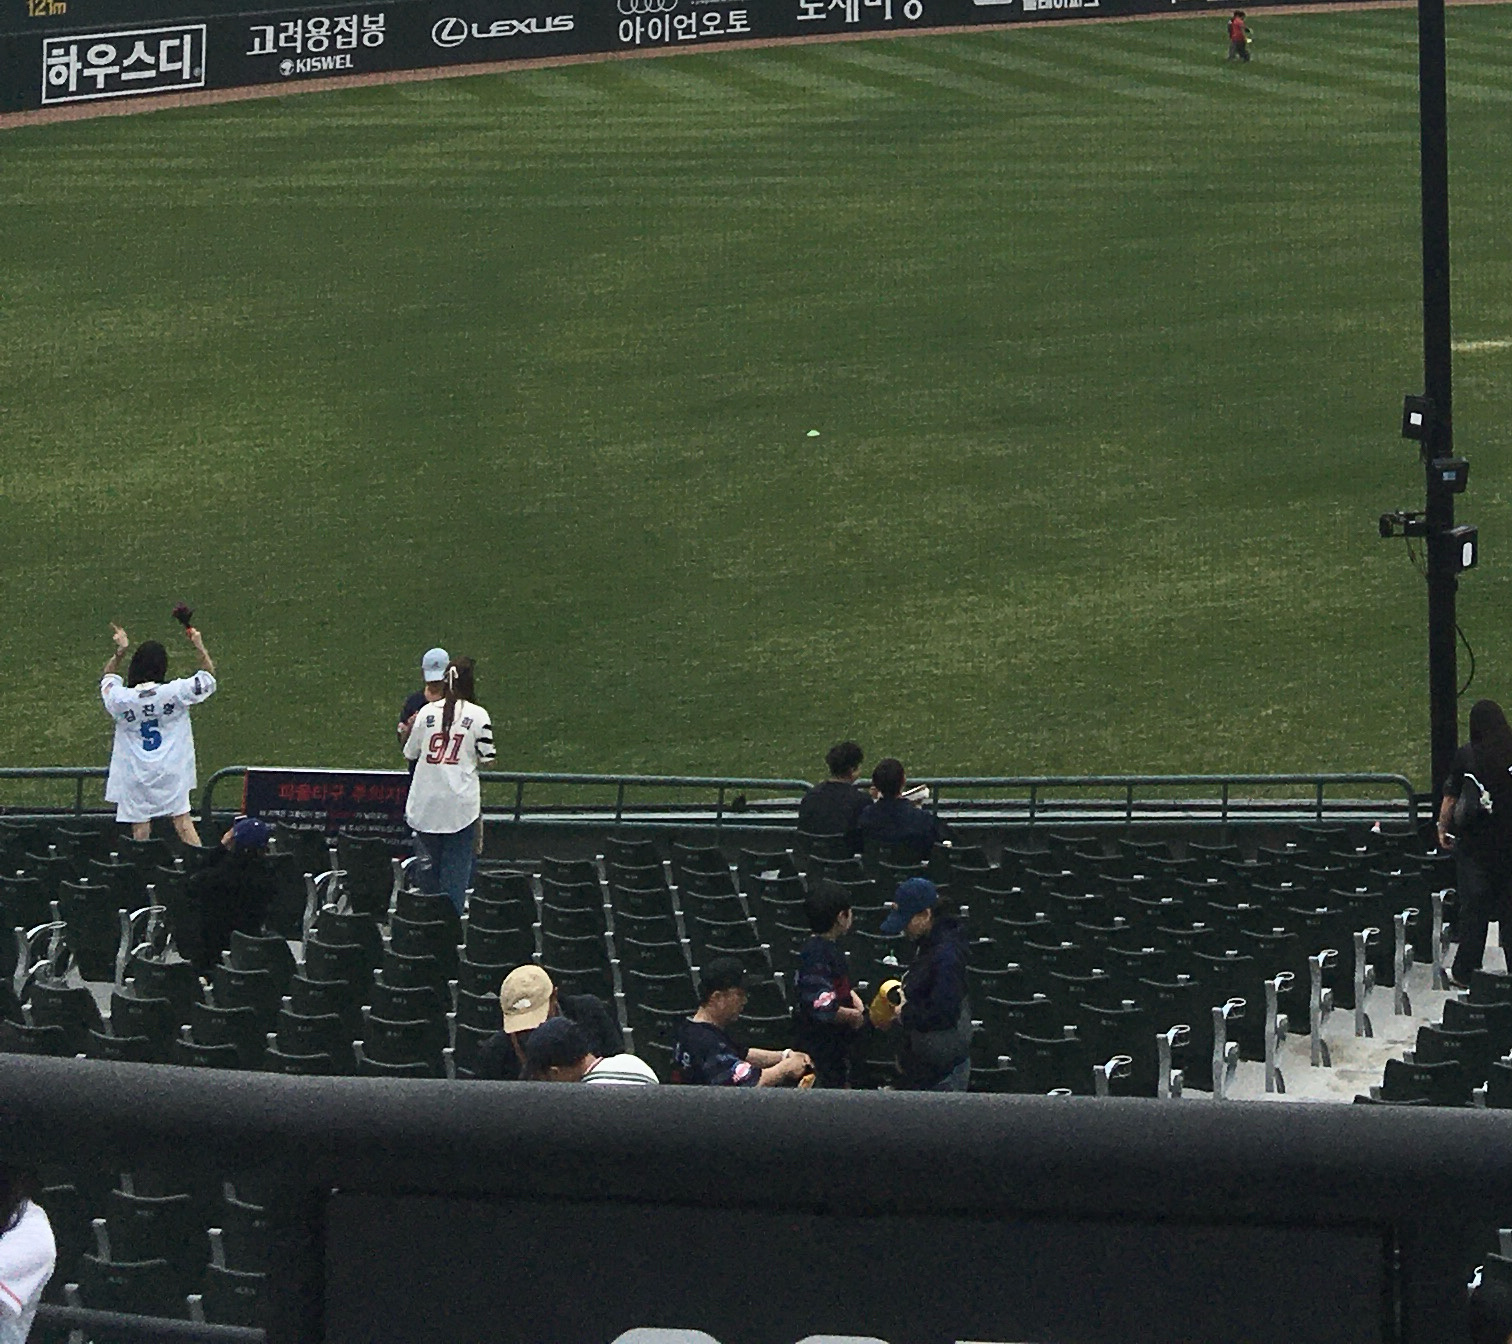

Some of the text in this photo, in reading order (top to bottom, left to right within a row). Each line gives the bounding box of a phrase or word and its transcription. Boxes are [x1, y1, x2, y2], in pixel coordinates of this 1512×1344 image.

[246, 12, 386, 58] 고려용접봉
[471, 14, 575, 40] LEXUS
[618, 10, 751, 46] 아이언오토
[46, 32, 193, 94] 하우스디
[295, 53, 354, 73] KISWEL
[140, 718, 163, 752] 5
[426, 732, 465, 765] 91
